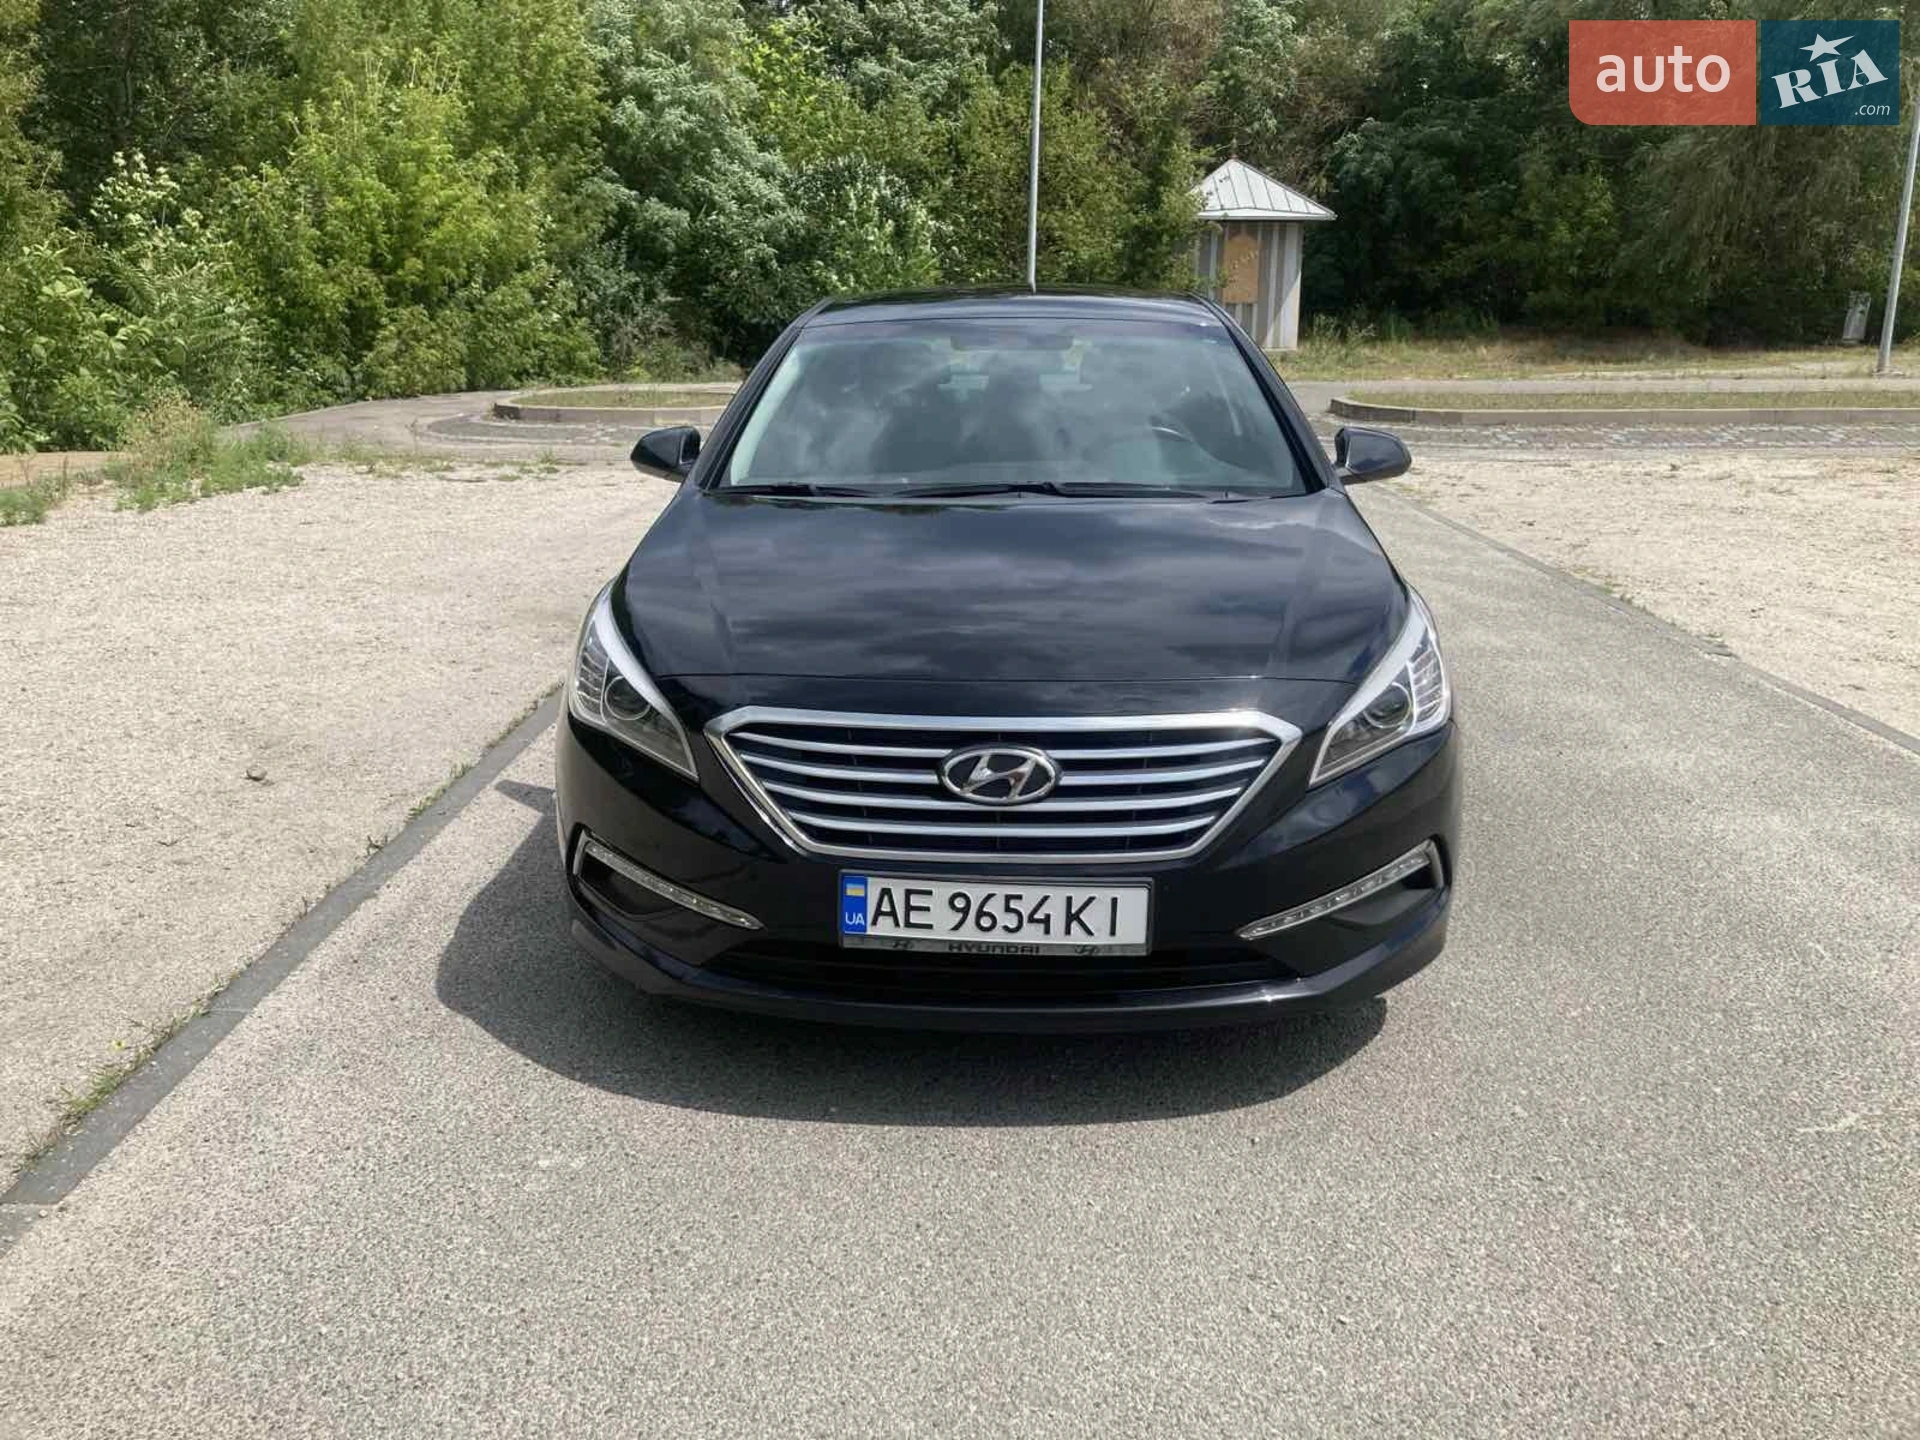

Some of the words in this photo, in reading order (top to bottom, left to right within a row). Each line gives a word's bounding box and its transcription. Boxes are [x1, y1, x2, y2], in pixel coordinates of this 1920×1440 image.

[844, 911, 865, 926] UA
[871, 887, 934, 930] AE
[948, 892, 1051, 936] 9654
[1064, 895, 1119, 937] KI
[948, 943, 1039, 954] HYUNDAI
